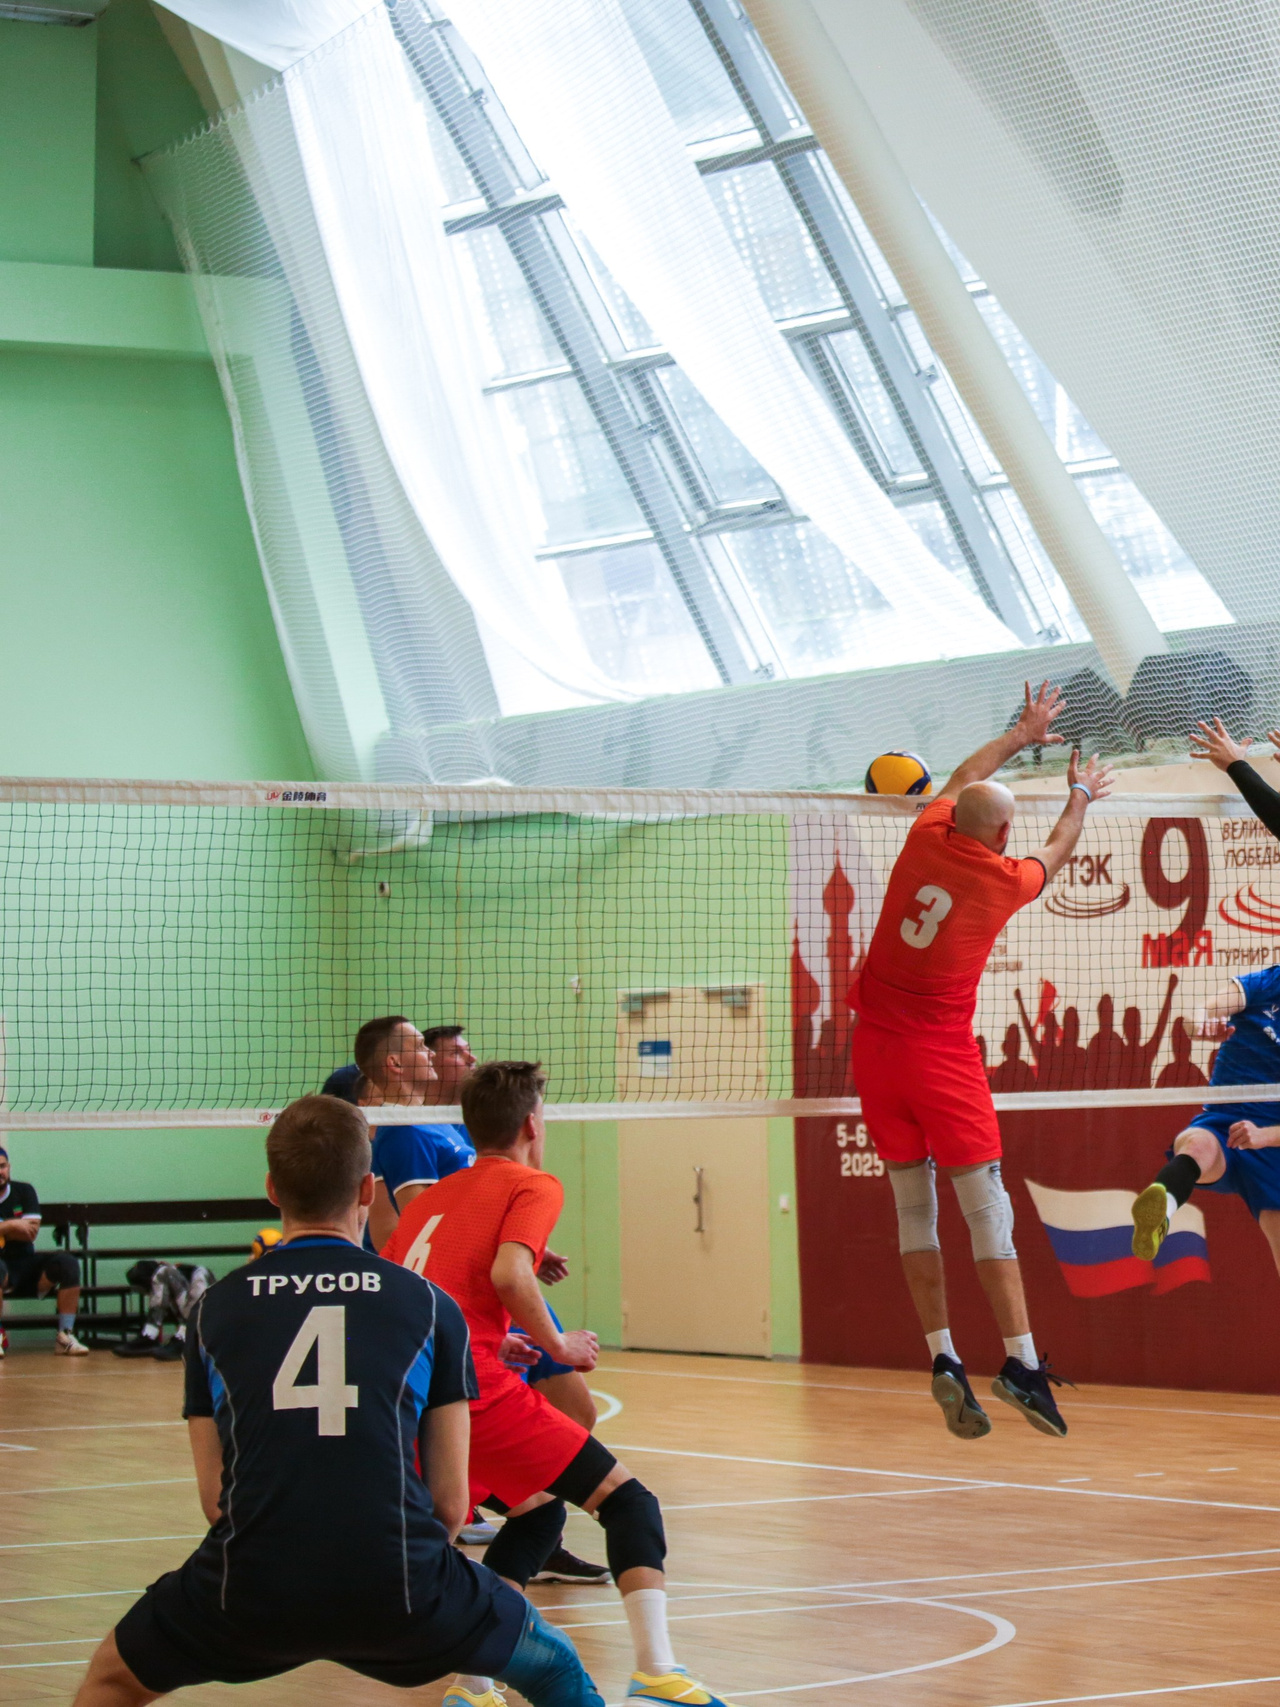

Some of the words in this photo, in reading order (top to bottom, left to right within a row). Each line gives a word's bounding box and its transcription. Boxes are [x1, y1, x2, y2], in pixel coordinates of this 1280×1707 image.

[1140, 817, 1210, 960] 9
[900, 884, 953, 949] 3
[1216, 947, 1270, 967] ТУРНИР
[837, 1123, 868, 1148] 5-6
[841, 1152, 885, 1177] 2025
[247, 1272, 382, 1297] ТРУСОВ
[272, 1305, 359, 1436] 4
